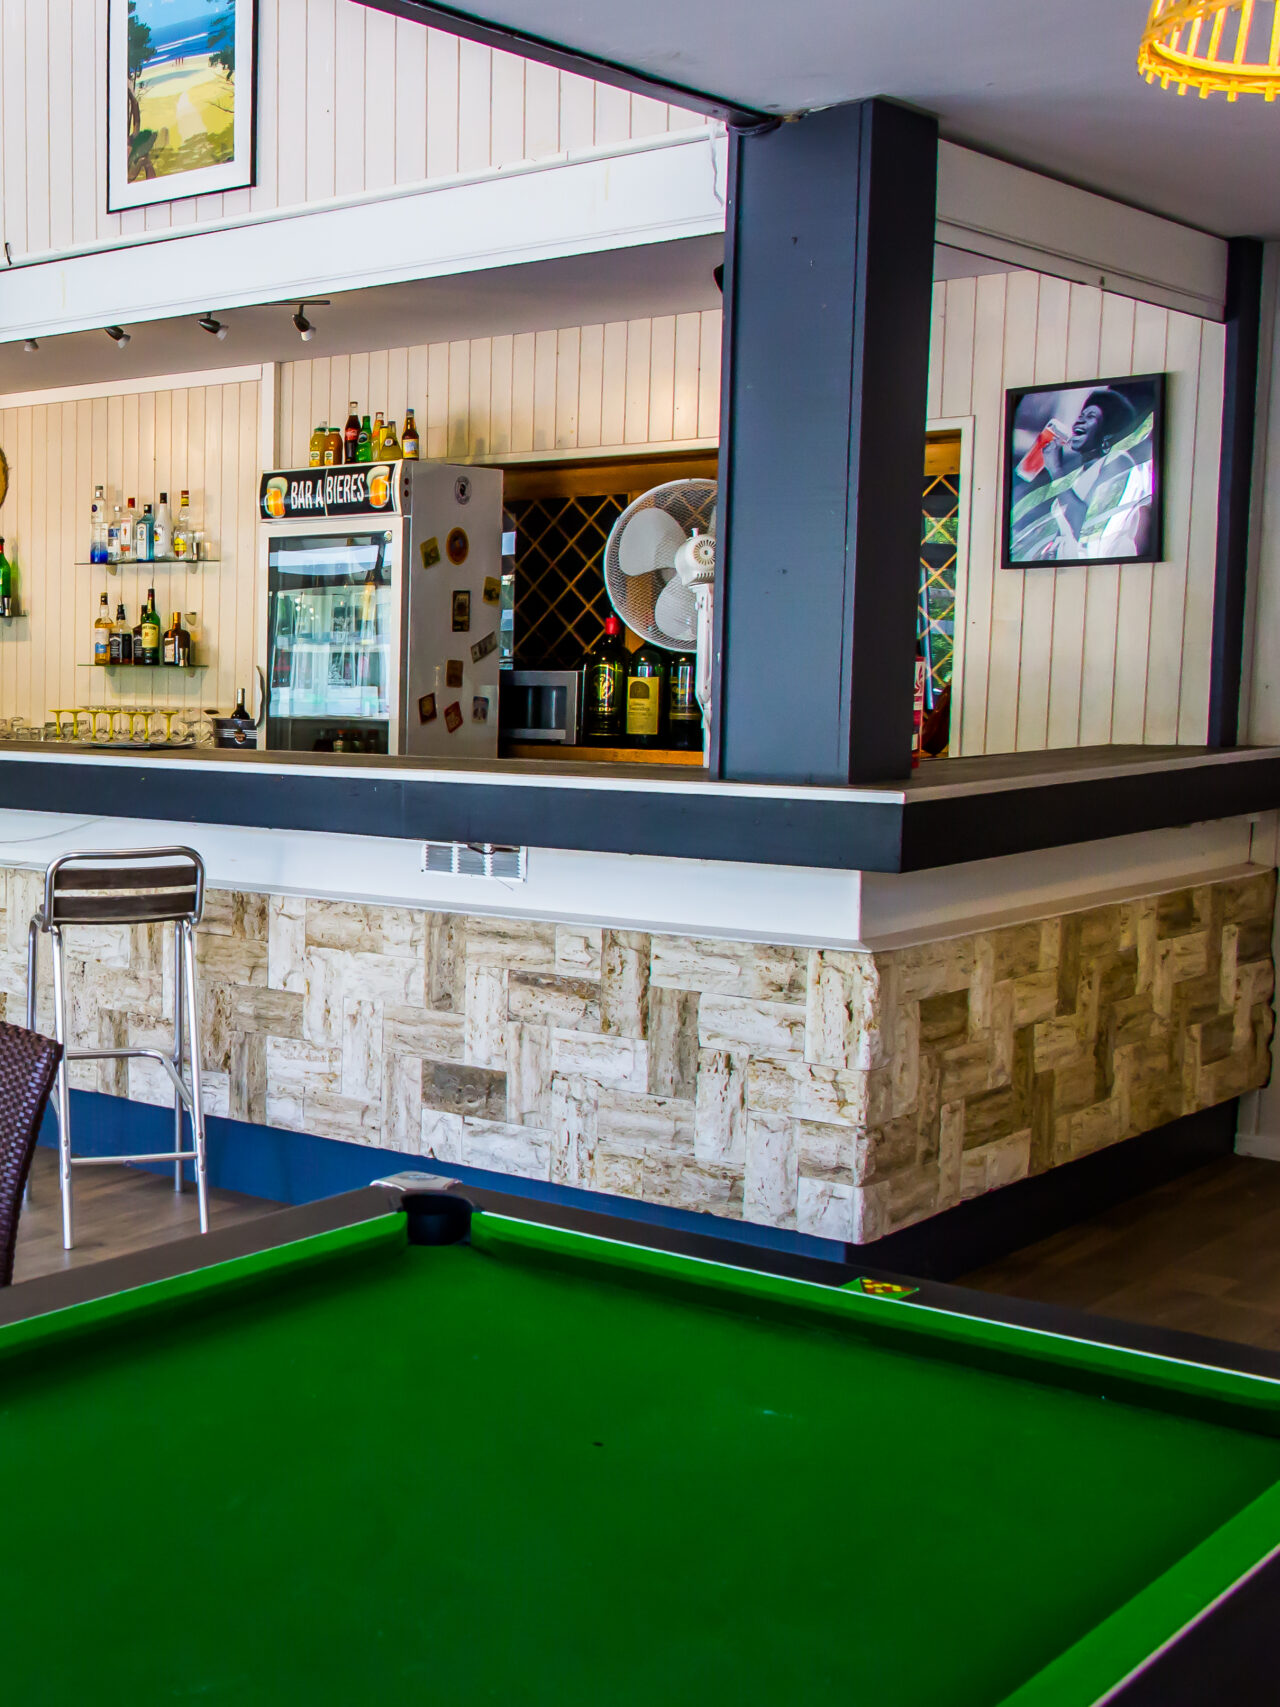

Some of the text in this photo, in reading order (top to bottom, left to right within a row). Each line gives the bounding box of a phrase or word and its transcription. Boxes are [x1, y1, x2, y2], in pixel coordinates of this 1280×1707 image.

[291, 473, 365, 509] BAR A BIERES
